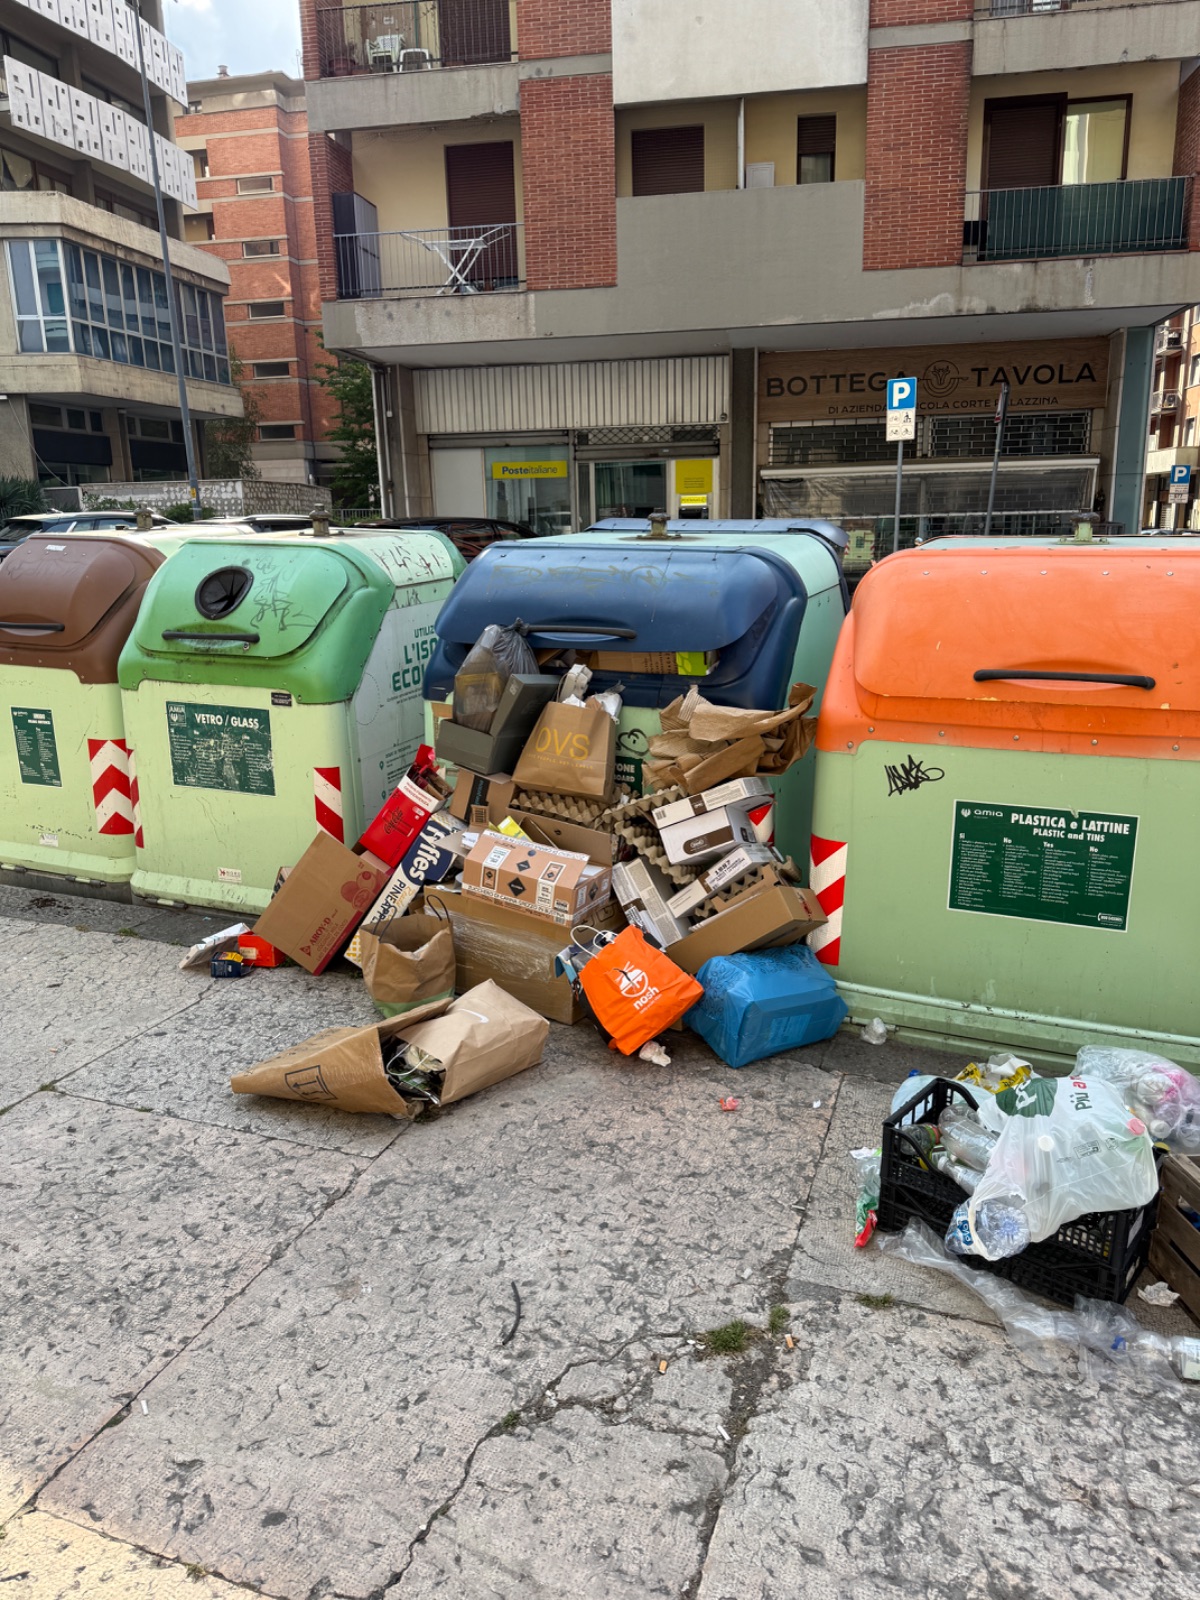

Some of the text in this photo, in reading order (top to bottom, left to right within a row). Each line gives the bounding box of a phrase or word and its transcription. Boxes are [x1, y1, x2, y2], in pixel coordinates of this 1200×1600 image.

[766, 362, 1097, 397] BOTTEG TAVOLA
[892, 381, 911, 407] P
[828, 406, 838, 414] DI
[953, 399, 991, 409] CORTE
[1173, 466, 1188, 483] P
[195, 713, 223, 725] VETRO
[230, 716, 259, 729] GLASS
[535, 726, 590, 761] OVS
[973, 808, 1003, 817] amia
[1010, 813, 1130, 835] PLASTICA e LATTINE
[1033, 828, 1105, 842] PLASTIC and TINS
[309, 917, 332, 945] AROY-D
[633, 986, 660, 1010] nosh
